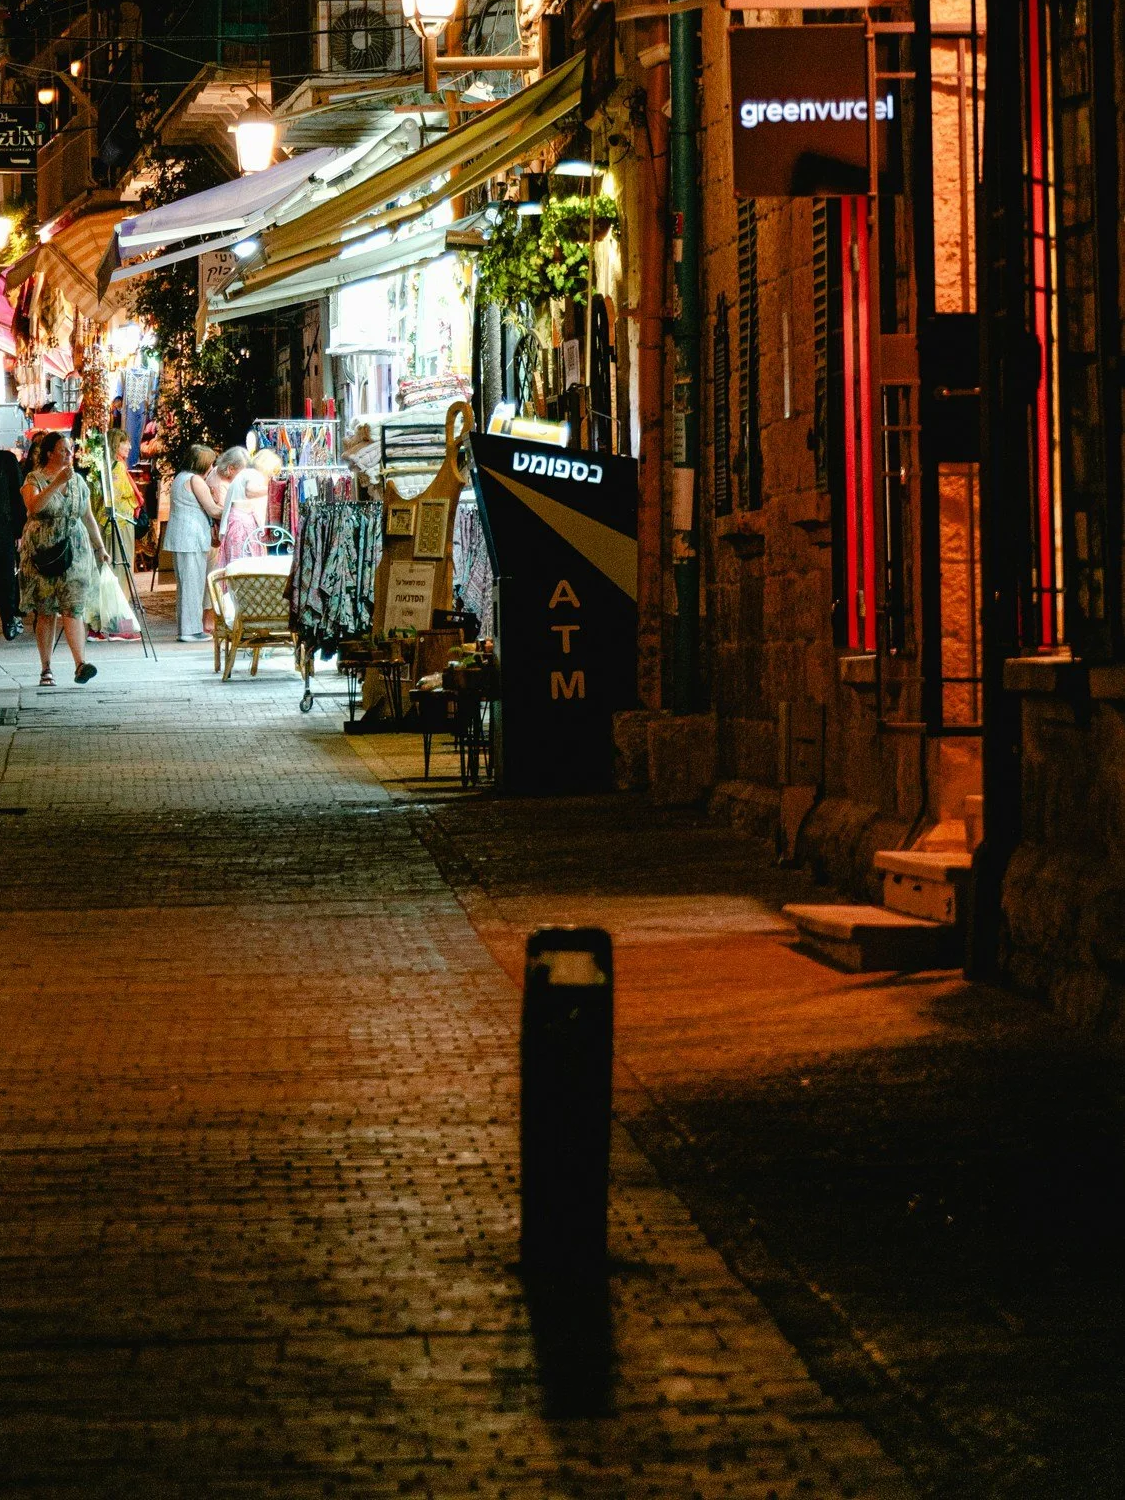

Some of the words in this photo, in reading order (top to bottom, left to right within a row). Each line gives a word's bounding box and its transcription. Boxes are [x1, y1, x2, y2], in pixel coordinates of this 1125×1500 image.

[740, 94, 894, 128] greenvurcel
[512, 452, 603, 484] כספומט
[548, 579, 586, 700] ATM
